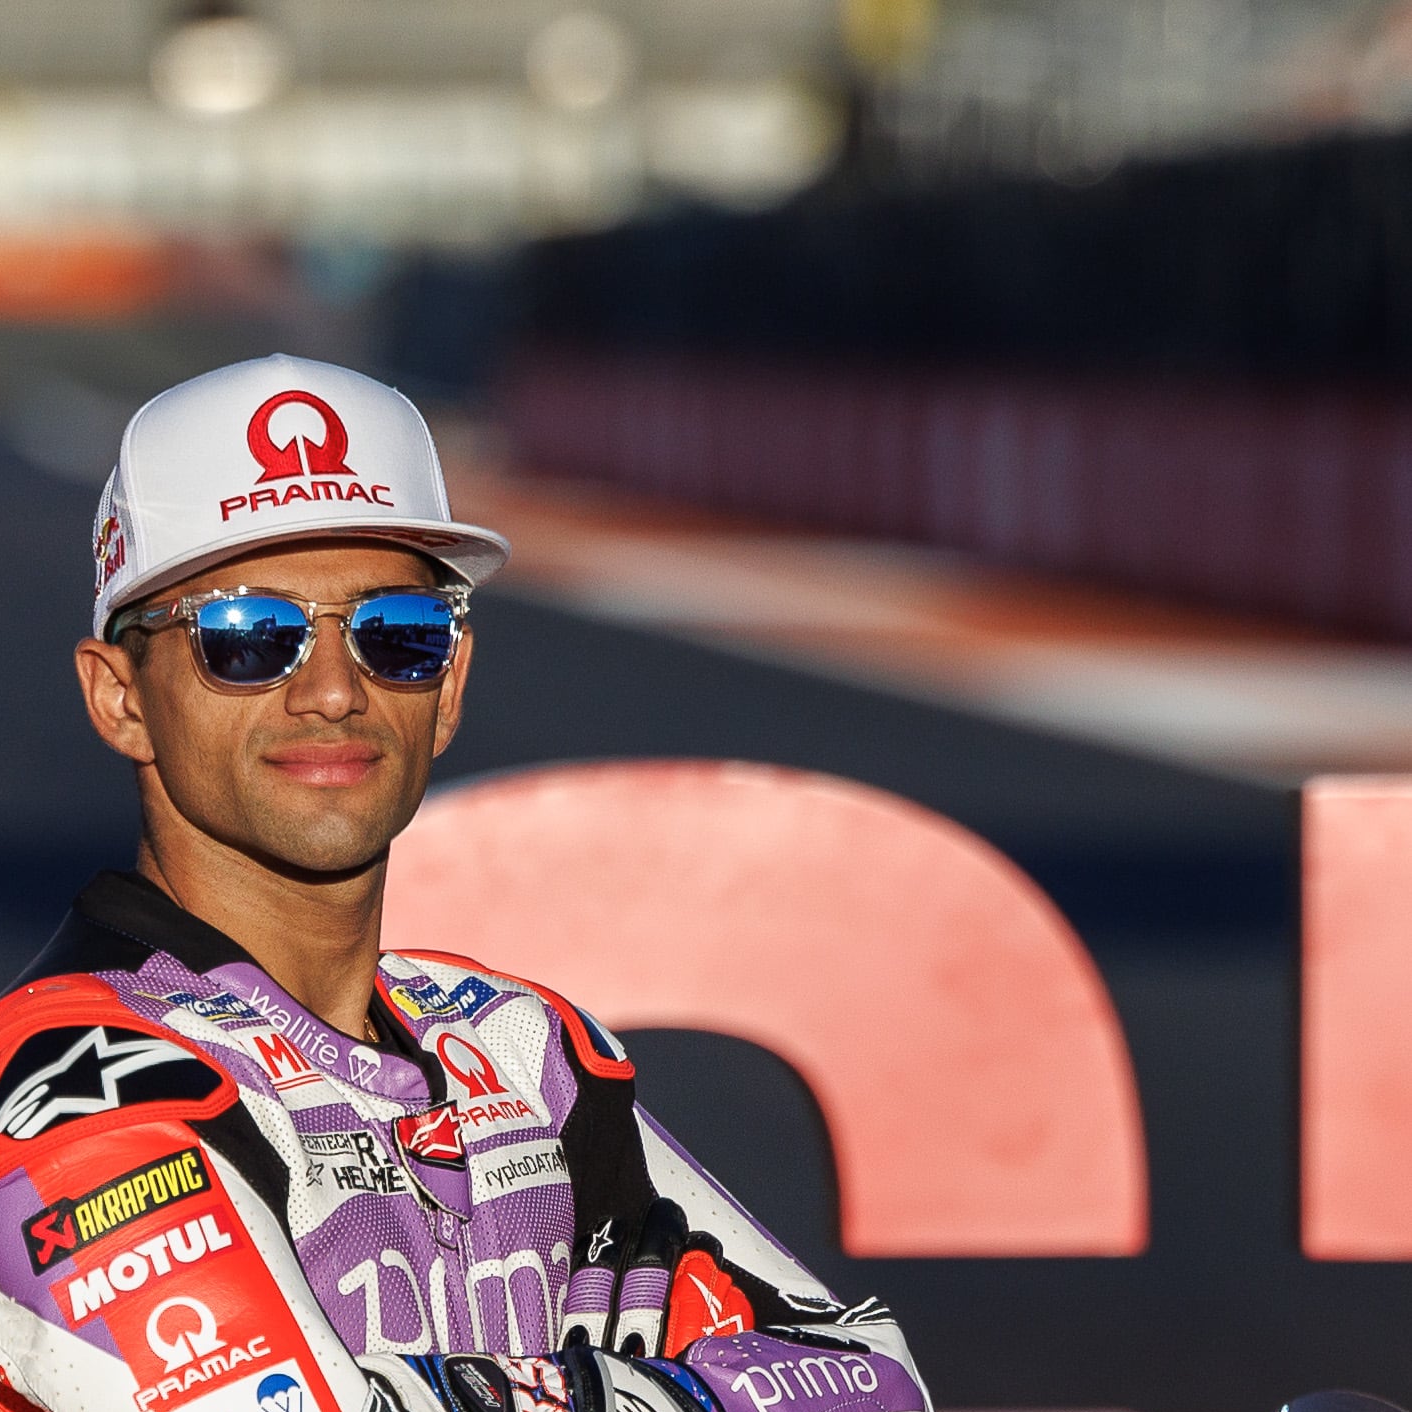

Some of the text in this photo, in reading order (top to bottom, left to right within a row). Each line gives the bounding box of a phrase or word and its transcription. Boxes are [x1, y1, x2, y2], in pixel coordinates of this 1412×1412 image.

[219, 481, 395, 521] PRAMAC
[247, 985, 341, 1066] wallife
[458, 1098, 536, 1129] PRAMA
[75, 1152, 205, 1242] AKRAPOVIČ
[67, 1213, 232, 1321] MOTUL
